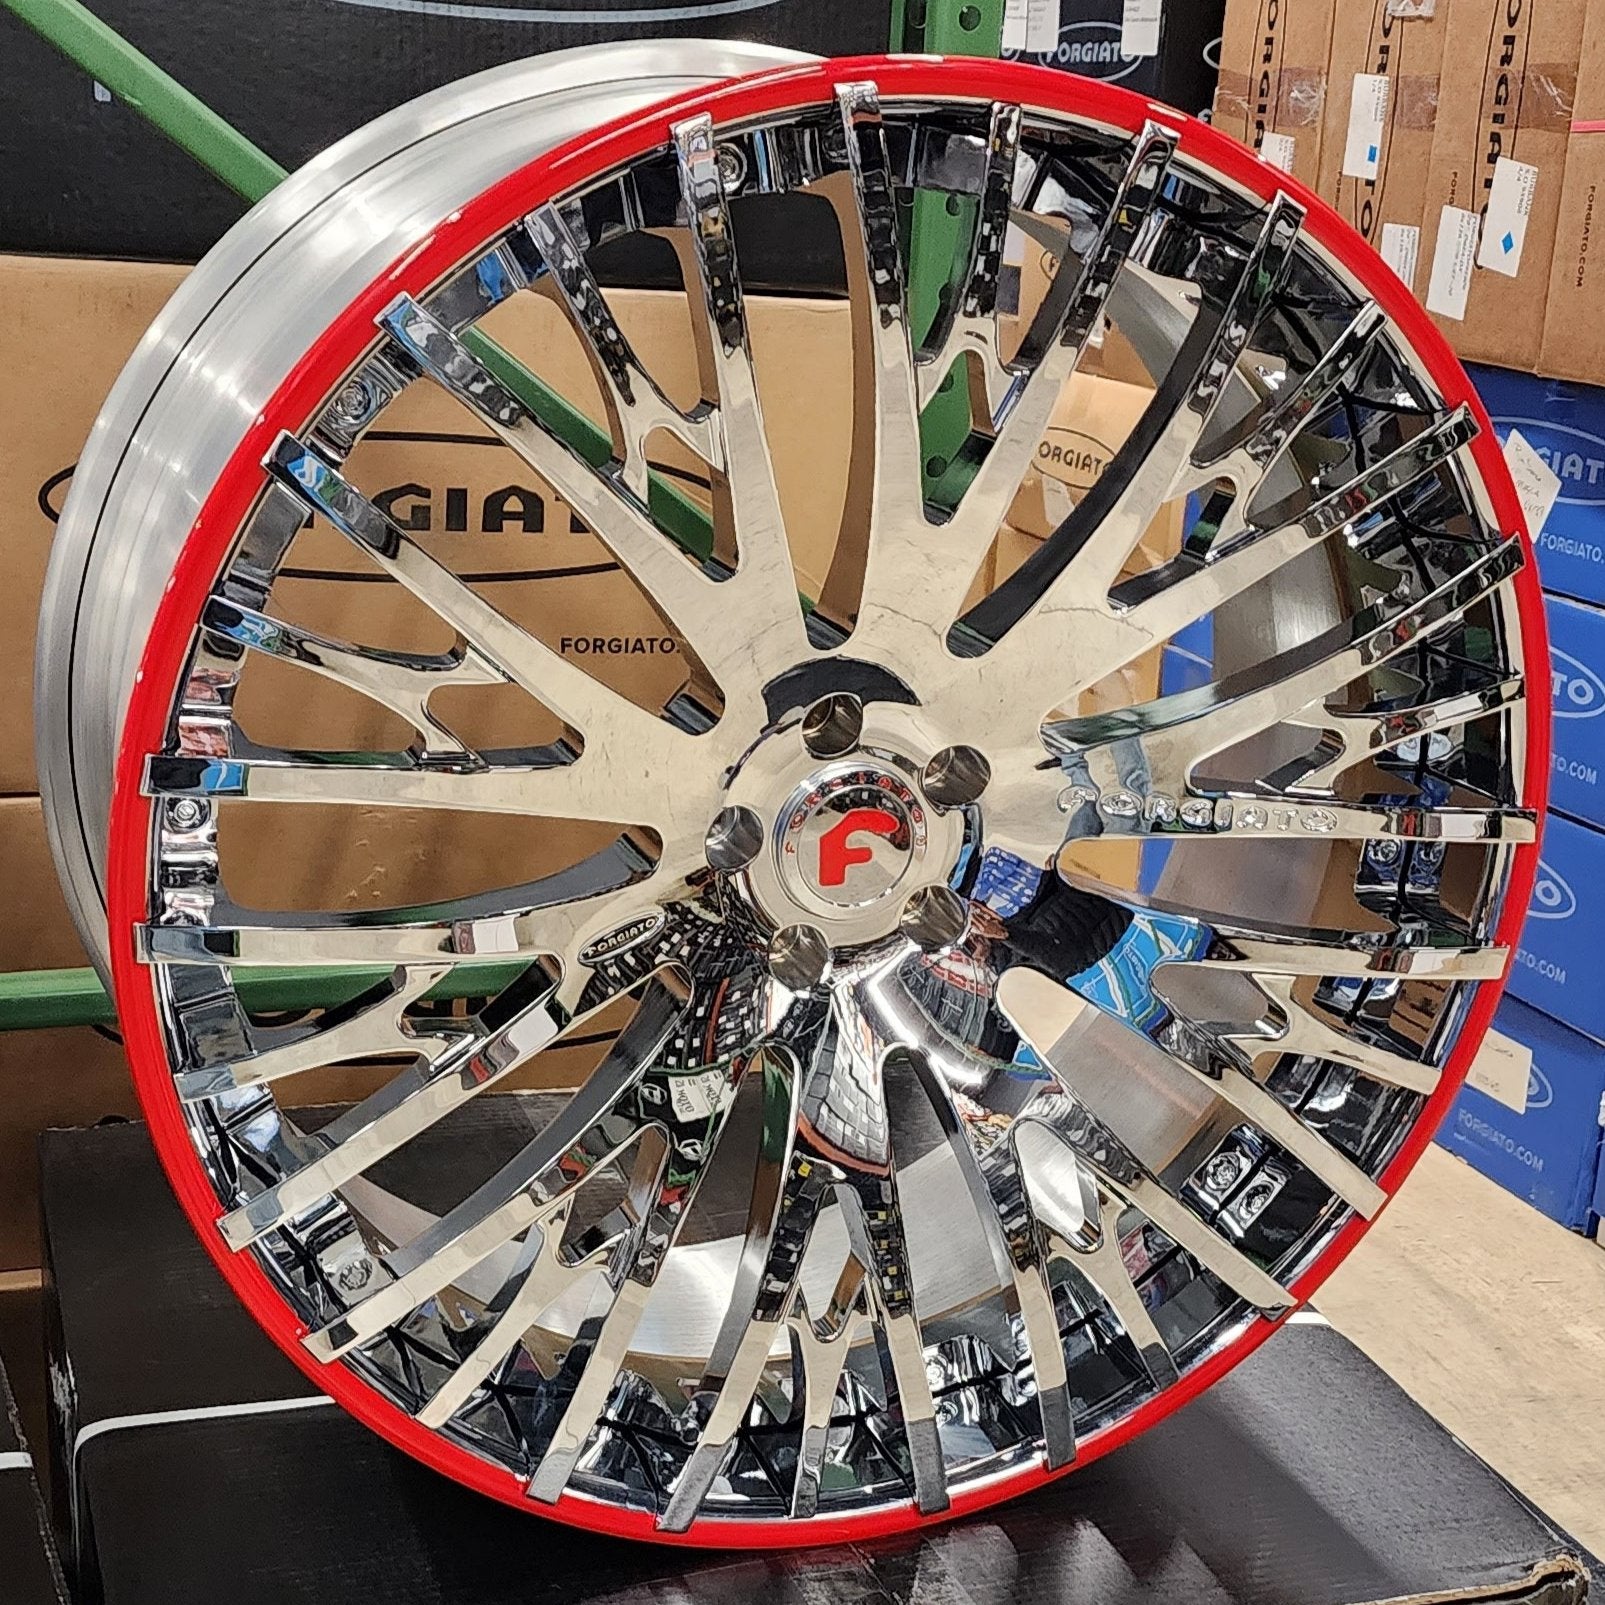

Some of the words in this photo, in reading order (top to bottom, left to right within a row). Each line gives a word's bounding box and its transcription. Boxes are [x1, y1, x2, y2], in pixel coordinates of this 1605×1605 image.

[1046, 40, 1134, 63] ORGIAT
[1254, 0, 1278, 148] ORGIA
[1576, 185, 1596, 288] FORGIATO.COM
[1038, 440, 1110, 476] ORGIAT
[1540, 532, 1605, 564] FORGIATO.
[560, 637, 681, 654] FORGIATO.
[1551, 753, 1598, 785] TO.COM
[818, 807, 900, 887] F
[584, 917, 657, 958] FORGIATO
[1458, 1107, 1544, 1173] FORGIATO.COM
